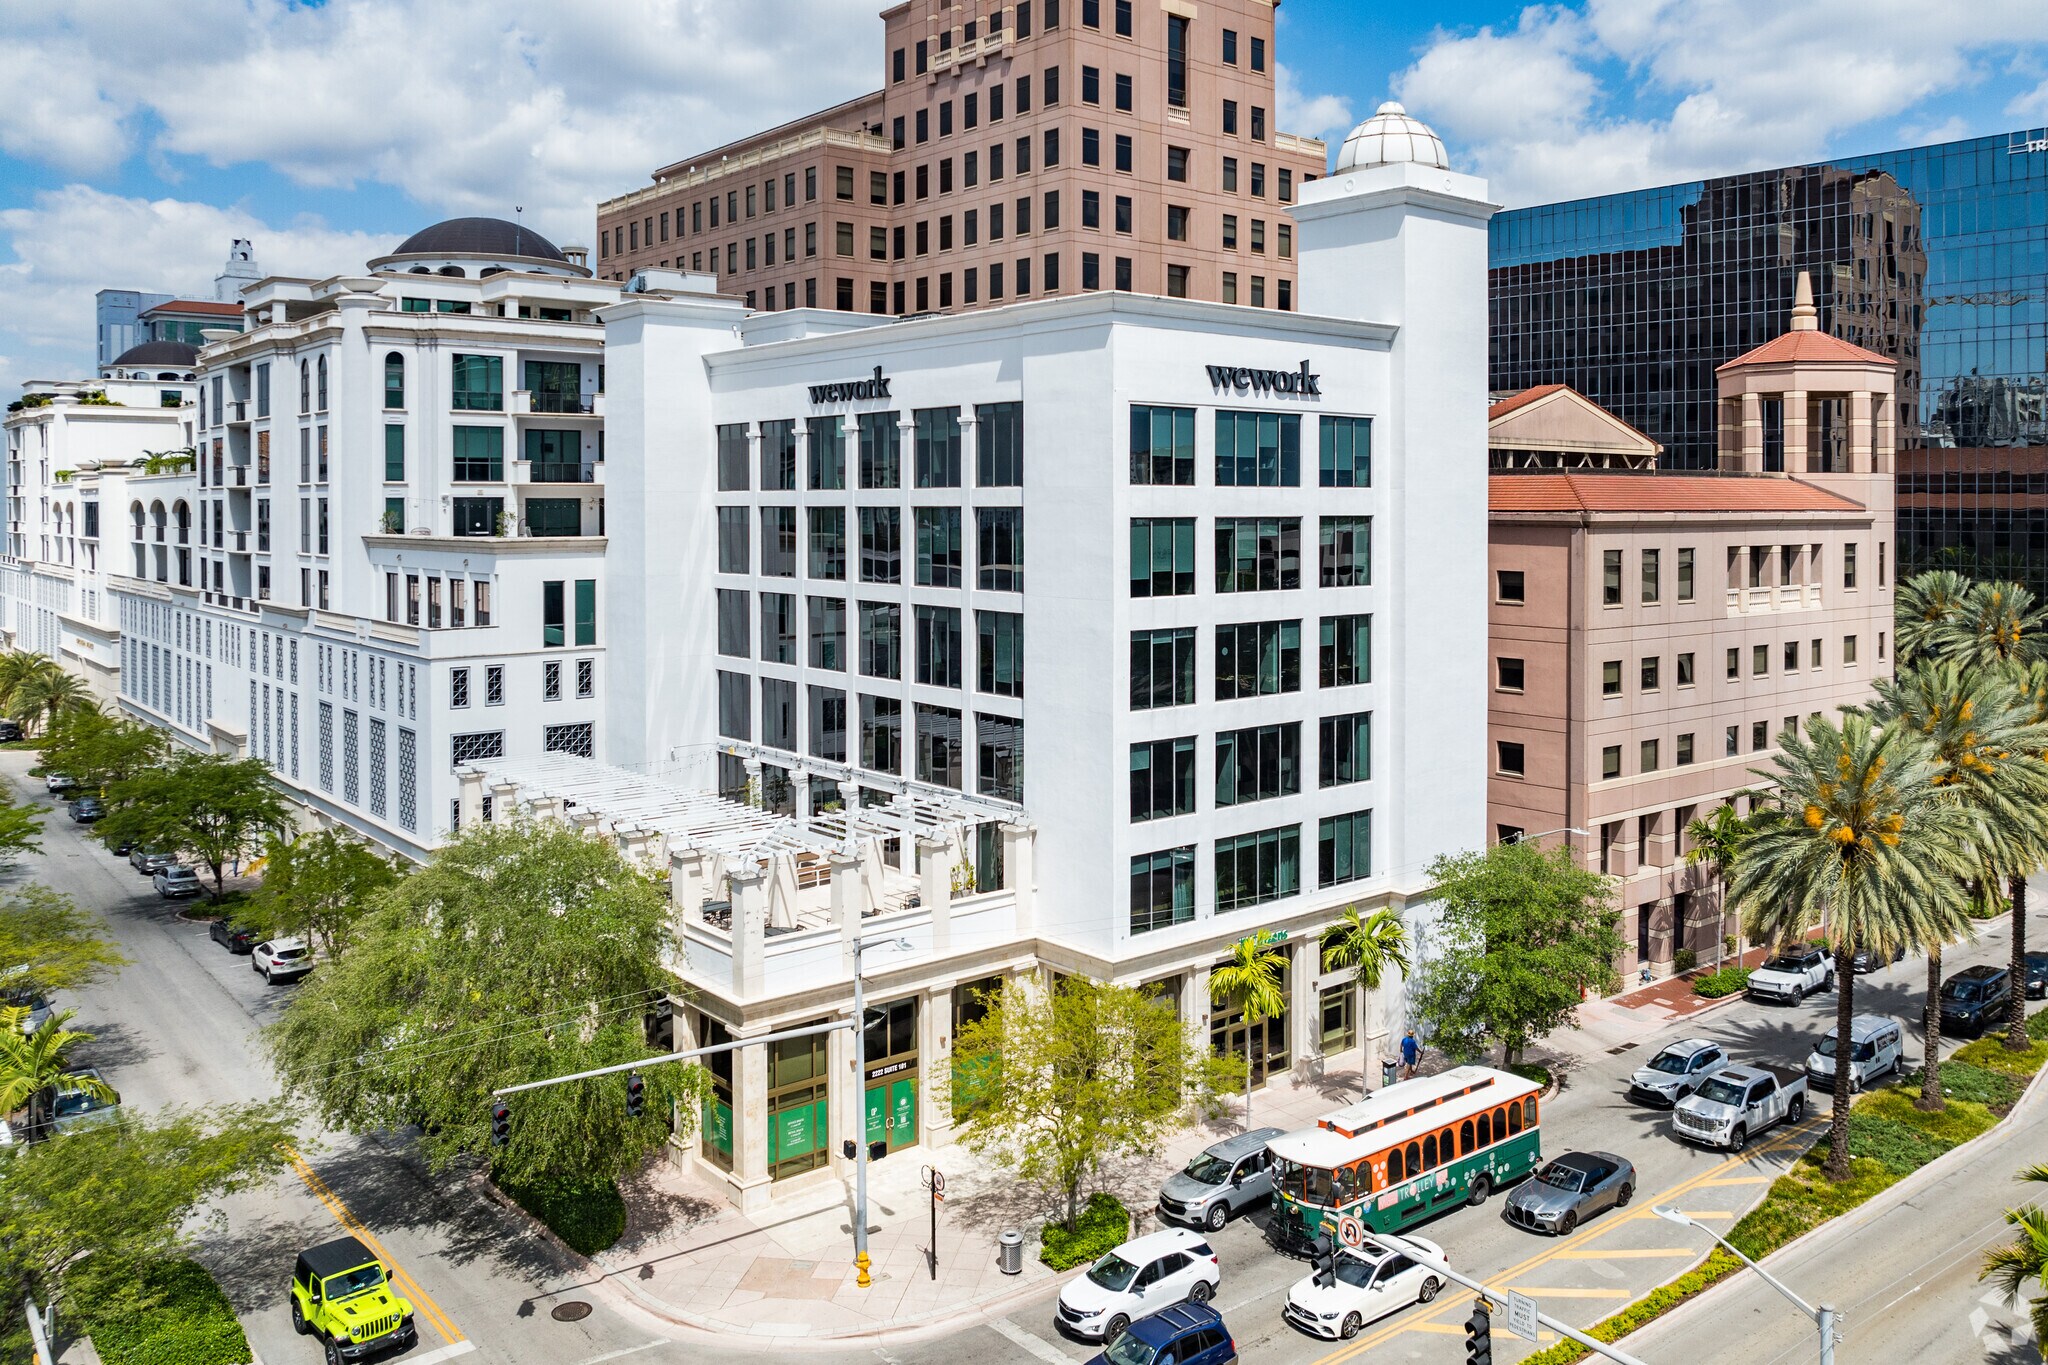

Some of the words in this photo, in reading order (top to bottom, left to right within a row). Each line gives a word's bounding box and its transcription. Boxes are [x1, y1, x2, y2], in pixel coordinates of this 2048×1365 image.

[1206, 359, 1321, 395] wework
[808, 366, 891, 404] wework
[884, 1065, 898, 1074] SUITE
[1399, 1176, 1435, 1201] TROLLEY
[1514, 1297, 1531, 1308] TURNING
[1514, 1304, 1530, 1314] TRAFFIC
[1515, 1310, 1530, 1321] MUST
[1514, 1317, 1525, 1326] YIELD
[1510, 1322, 1535, 1337] PEDESTRIANS
